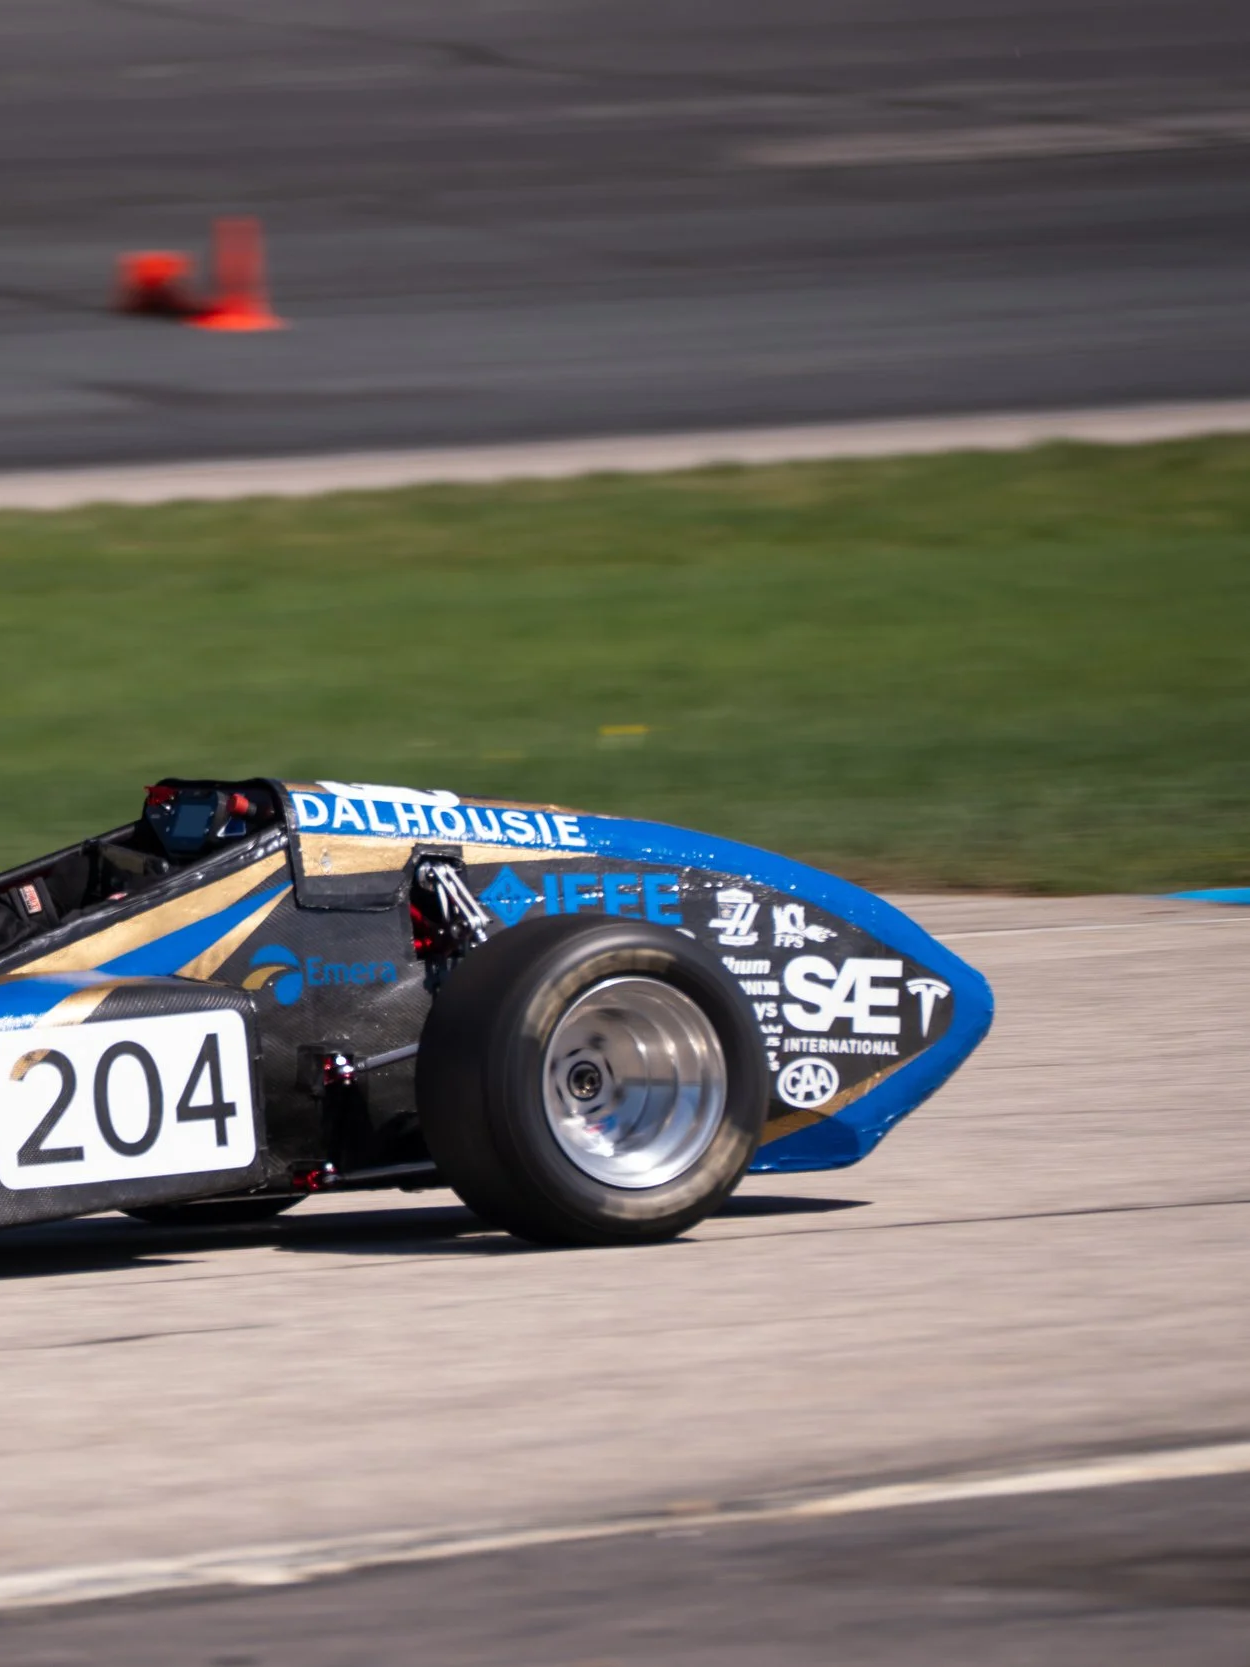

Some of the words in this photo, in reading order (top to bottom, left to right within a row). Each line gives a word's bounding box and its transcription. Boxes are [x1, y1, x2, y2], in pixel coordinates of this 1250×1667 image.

[291, 792, 588, 846] DALHOUSIE
[305, 957, 398, 987] Emera
[782, 955, 903, 1034] SAE
[784, 1038, 899, 1056] INTERNATIONAL
[11, 1034, 237, 1167] 204
[785, 1065, 831, 1101] CAA
